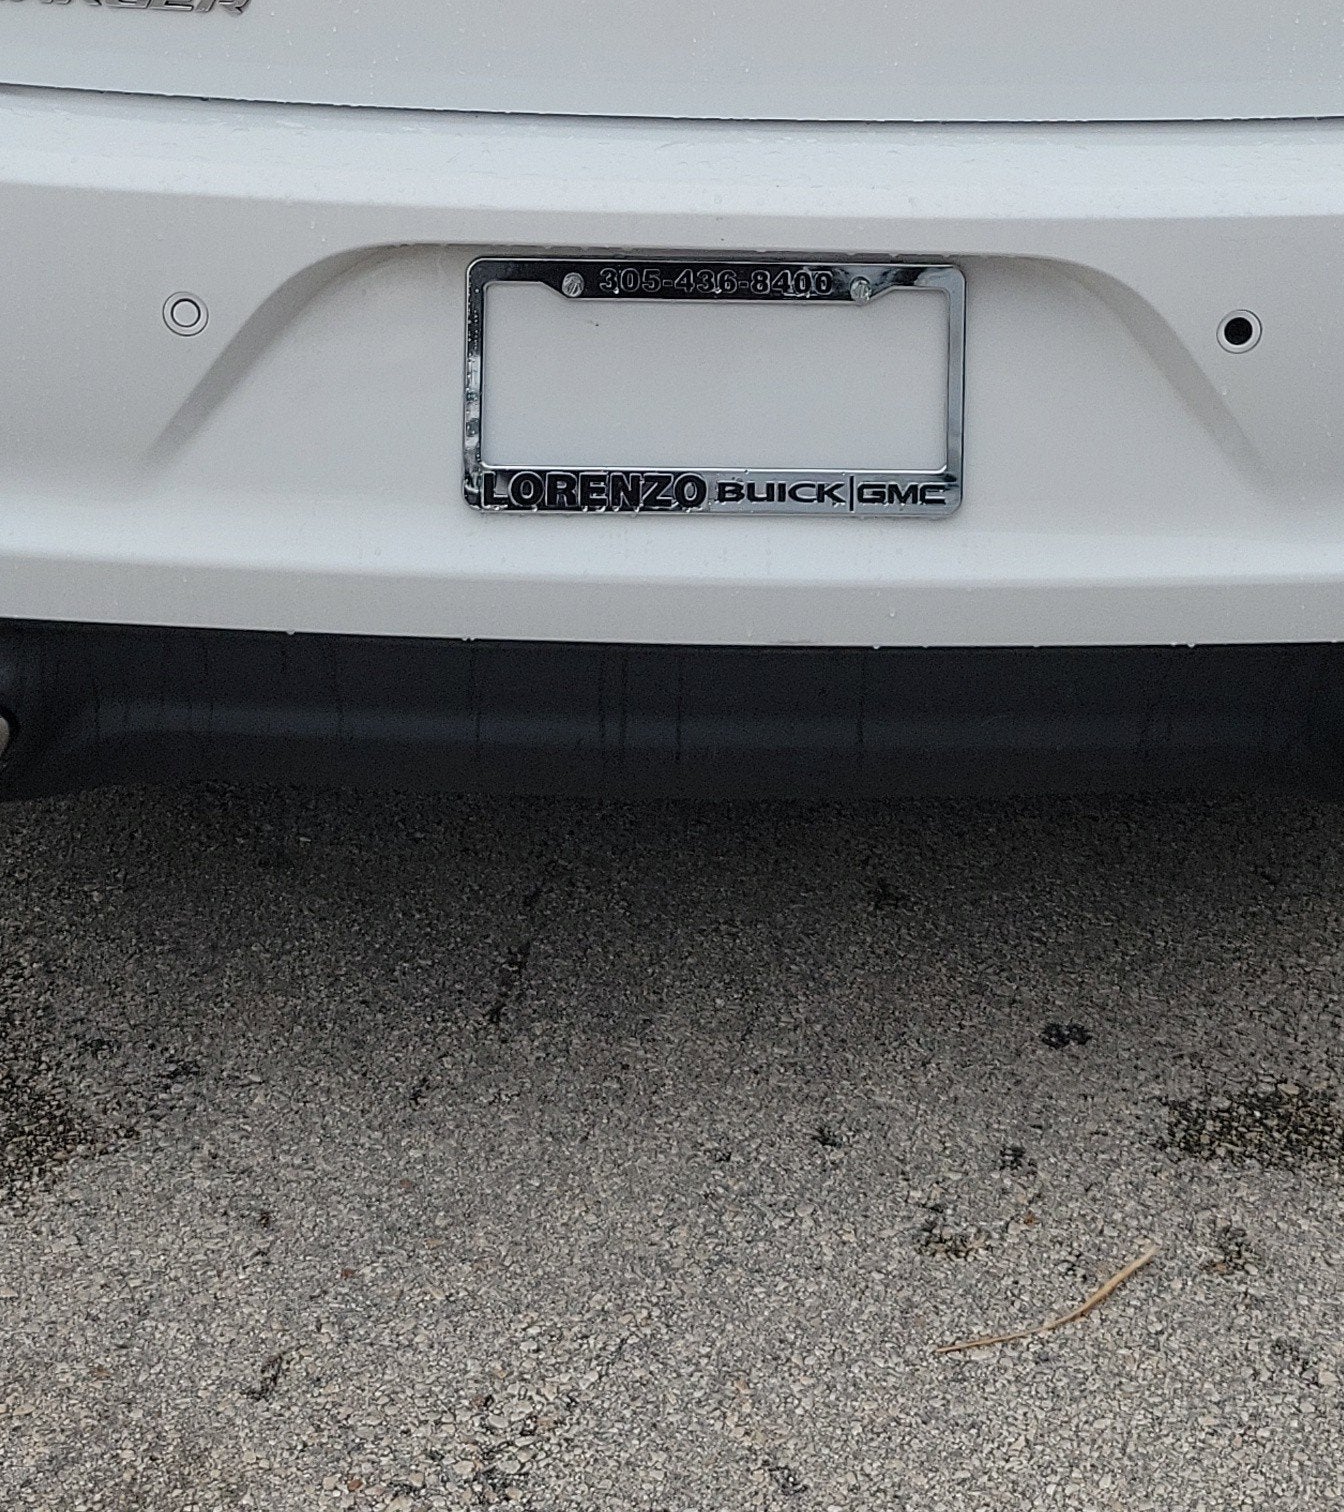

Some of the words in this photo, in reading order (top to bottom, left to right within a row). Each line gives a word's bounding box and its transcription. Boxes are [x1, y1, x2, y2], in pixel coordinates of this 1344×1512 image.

[598, 267, 835, 296] 305-436-8400
[481, 471, 707, 509] LORENZO
[716, 481, 847, 504] BUICK
[856, 482, 947, 505] GMC
